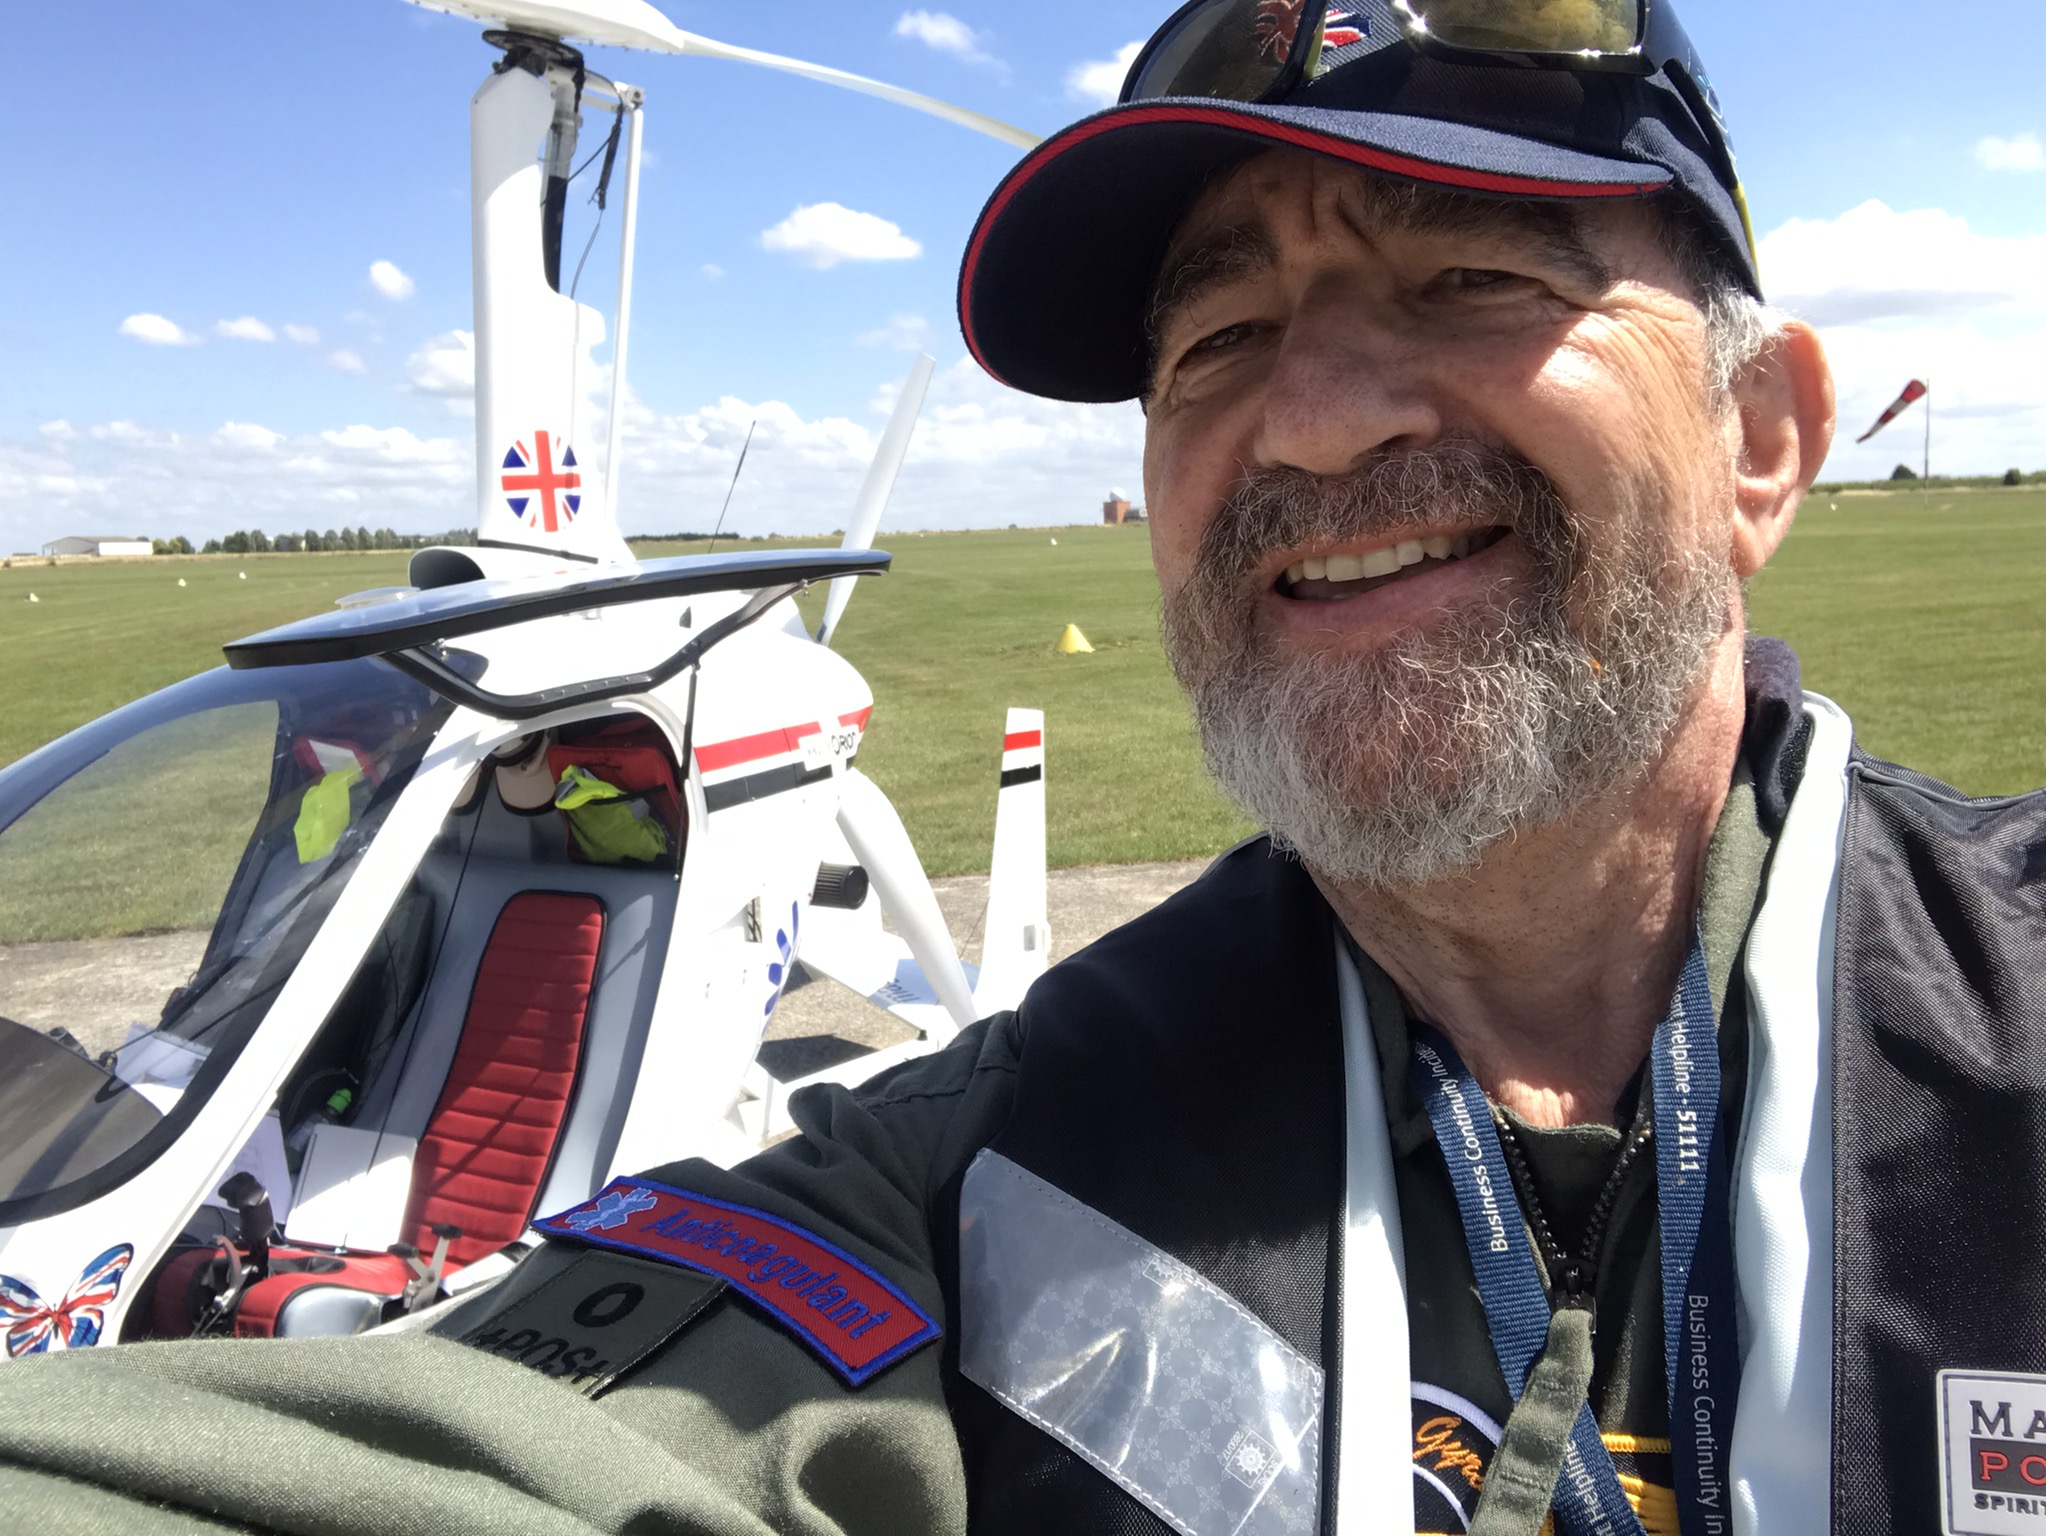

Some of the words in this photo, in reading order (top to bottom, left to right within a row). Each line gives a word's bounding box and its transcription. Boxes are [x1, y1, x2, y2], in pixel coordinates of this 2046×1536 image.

[1667, 1022, 1695, 1093] Helpline
[1438, 1077, 1482, 1161] Continuity
[1677, 1109, 1700, 1172] 51111
[1474, 1166, 1509, 1252] Business
[639, 1208, 893, 1341] Anticoagulant
[1688, 1294, 1711, 1390] Business
[1694, 1395, 1722, 1508] Continuity
